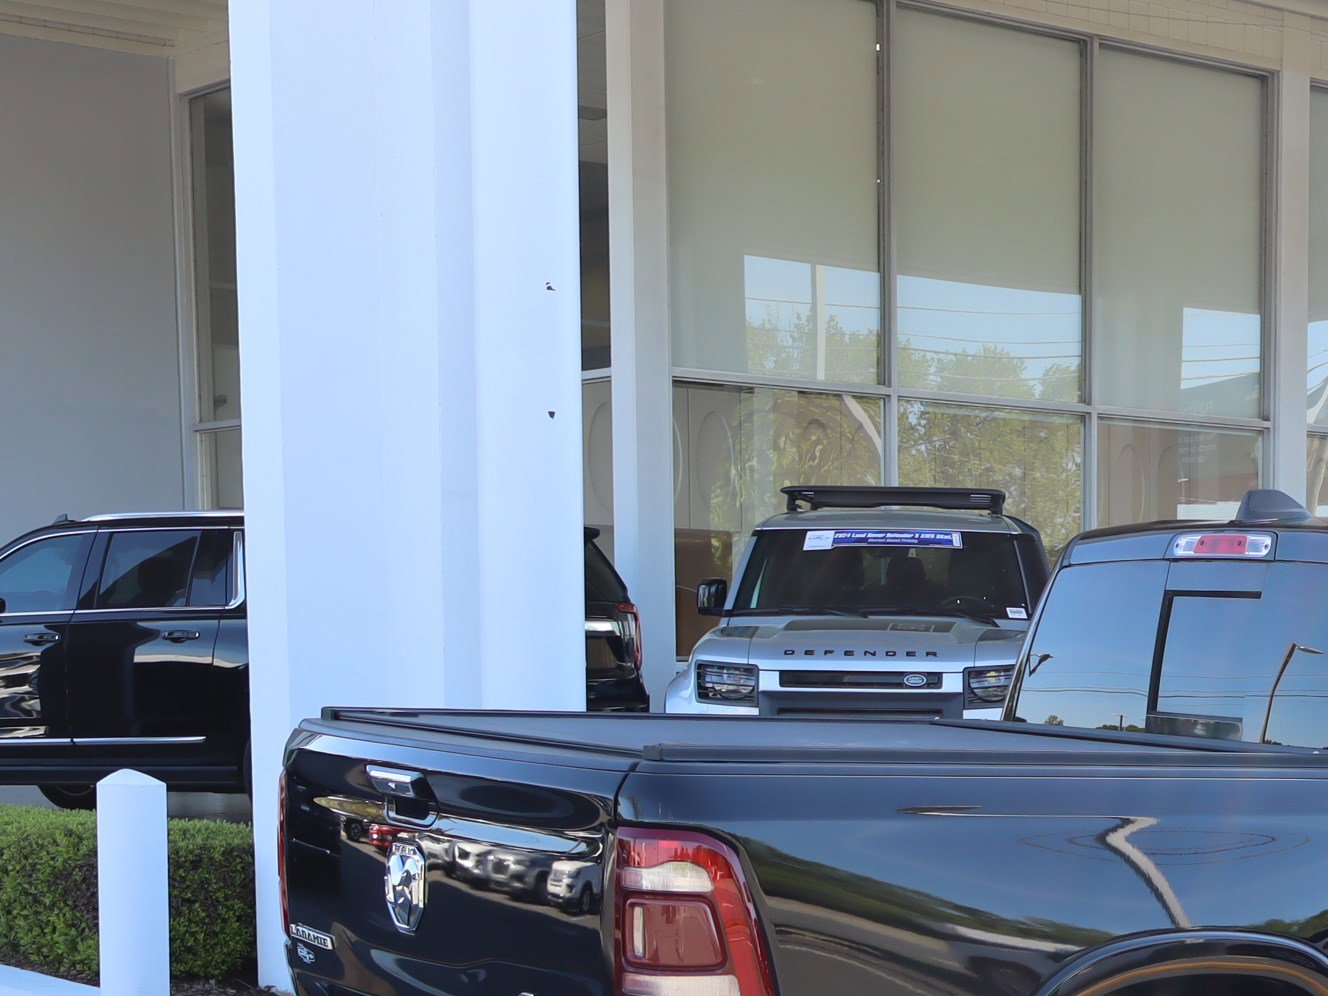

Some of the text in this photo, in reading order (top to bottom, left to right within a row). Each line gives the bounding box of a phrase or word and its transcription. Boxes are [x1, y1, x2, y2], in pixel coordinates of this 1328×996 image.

[783, 649, 938, 658] DEFENDER
[392, 844, 415, 855] RAM
[290, 924, 331, 949] LARAMIE
